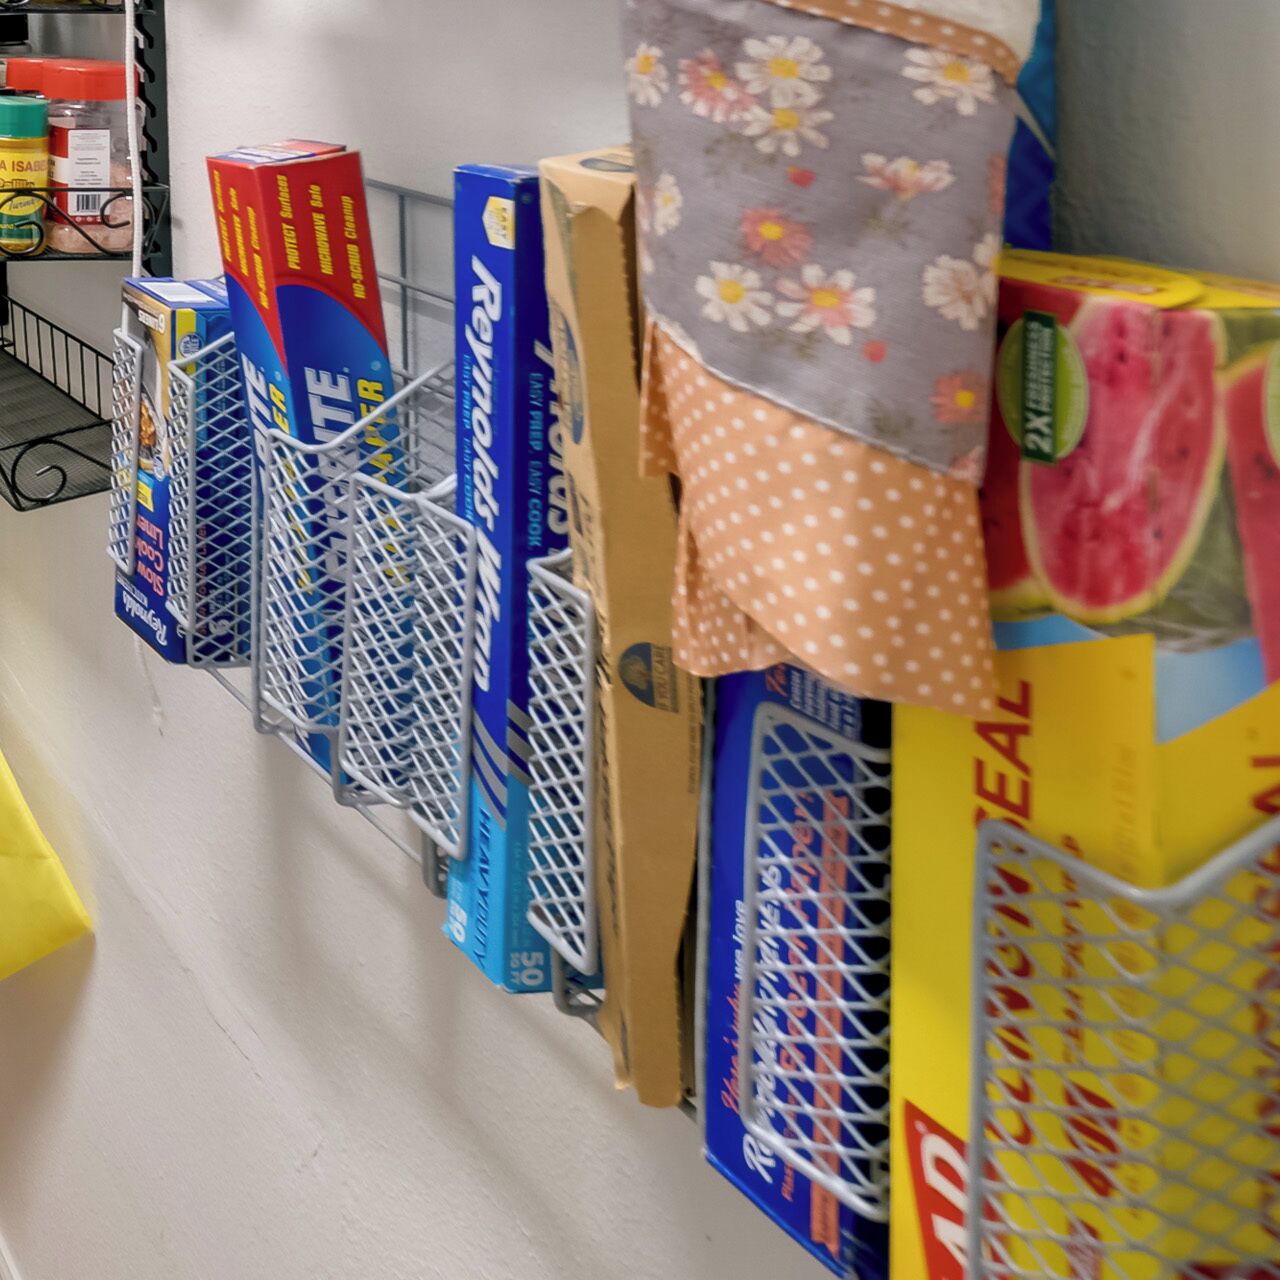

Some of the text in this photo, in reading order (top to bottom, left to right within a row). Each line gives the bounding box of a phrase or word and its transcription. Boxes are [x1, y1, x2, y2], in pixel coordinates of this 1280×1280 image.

[282, 223, 302, 270] PROTECT
[315, 219, 334, 276] MICROWAVE
[341, 195, 366, 300] NO-SCRUB Cleanup
[464, 254, 502, 532] Reynolds
[1024, 410, 1054, 455] 2X
[121, 589, 168, 645] Reynolds
[473, 526, 502, 692] Wrap
[519, 951, 545, 986] 50
